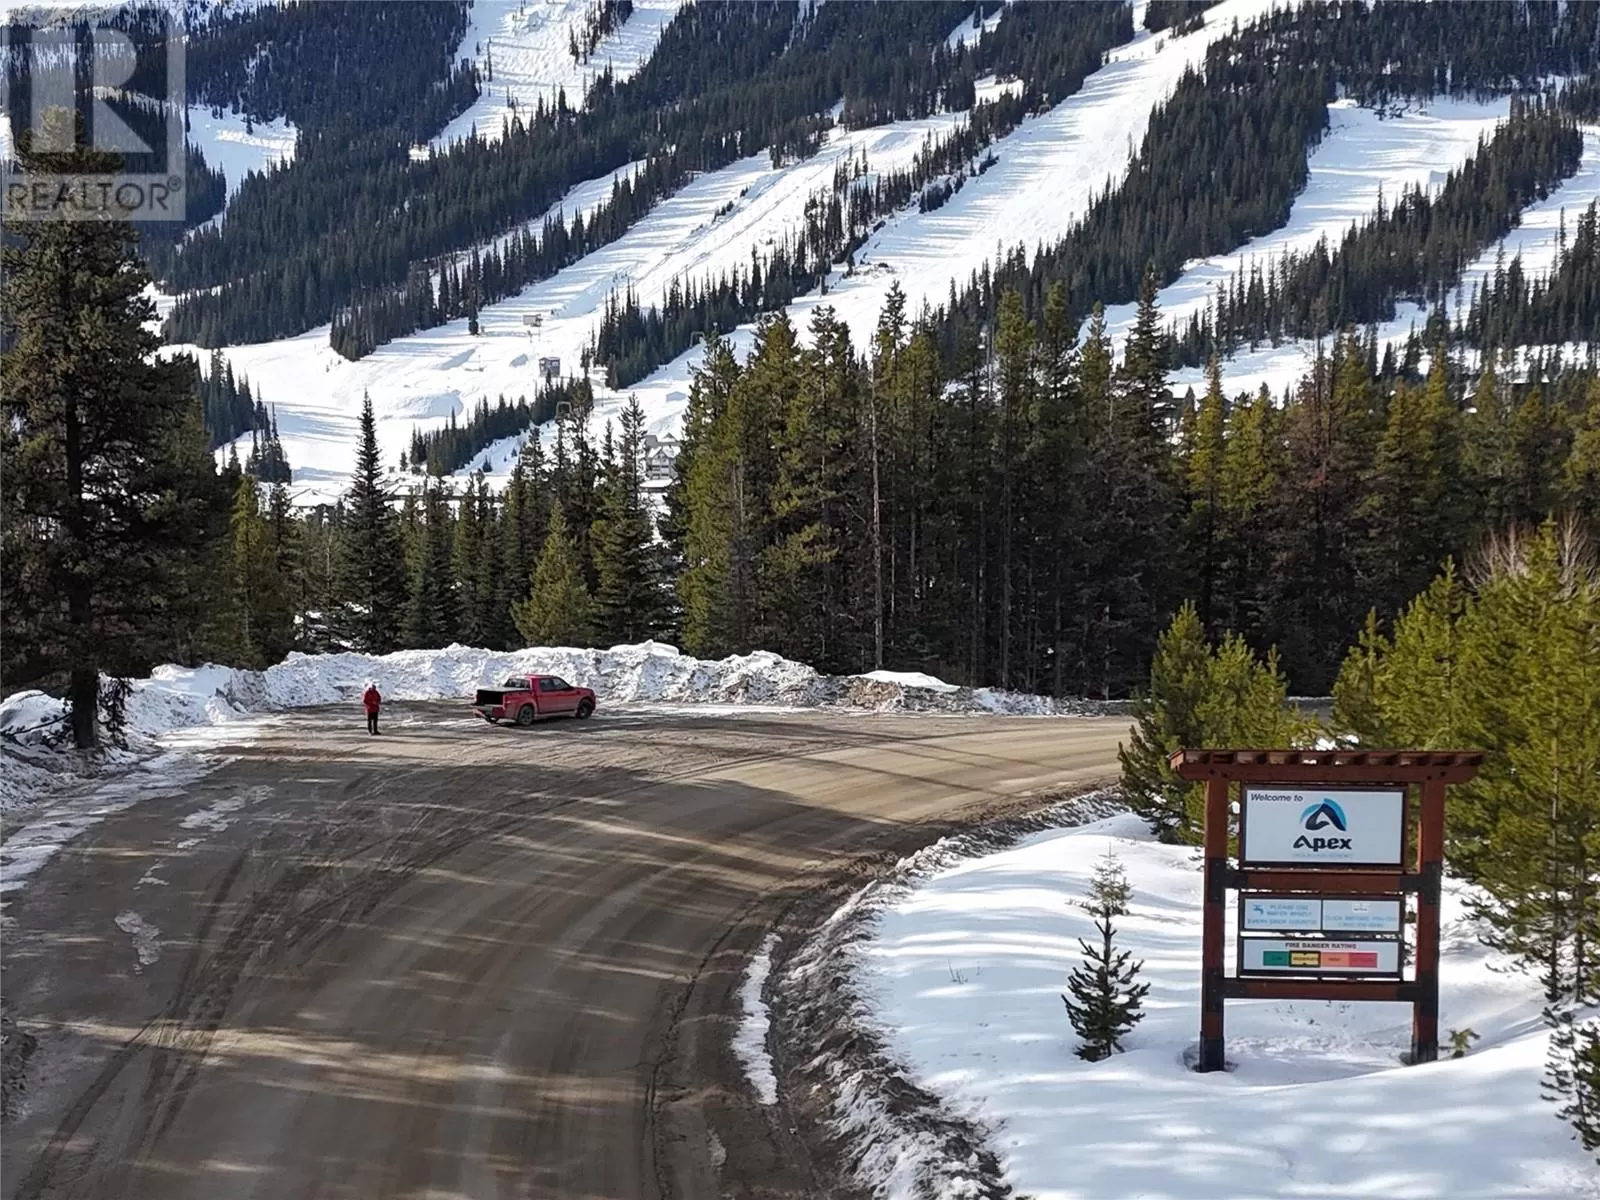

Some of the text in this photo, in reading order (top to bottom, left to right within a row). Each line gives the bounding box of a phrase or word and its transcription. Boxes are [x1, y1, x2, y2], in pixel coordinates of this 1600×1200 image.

[1250, 793, 1304, 802] Welcome to
[1292, 835, 1353, 852] Apex
